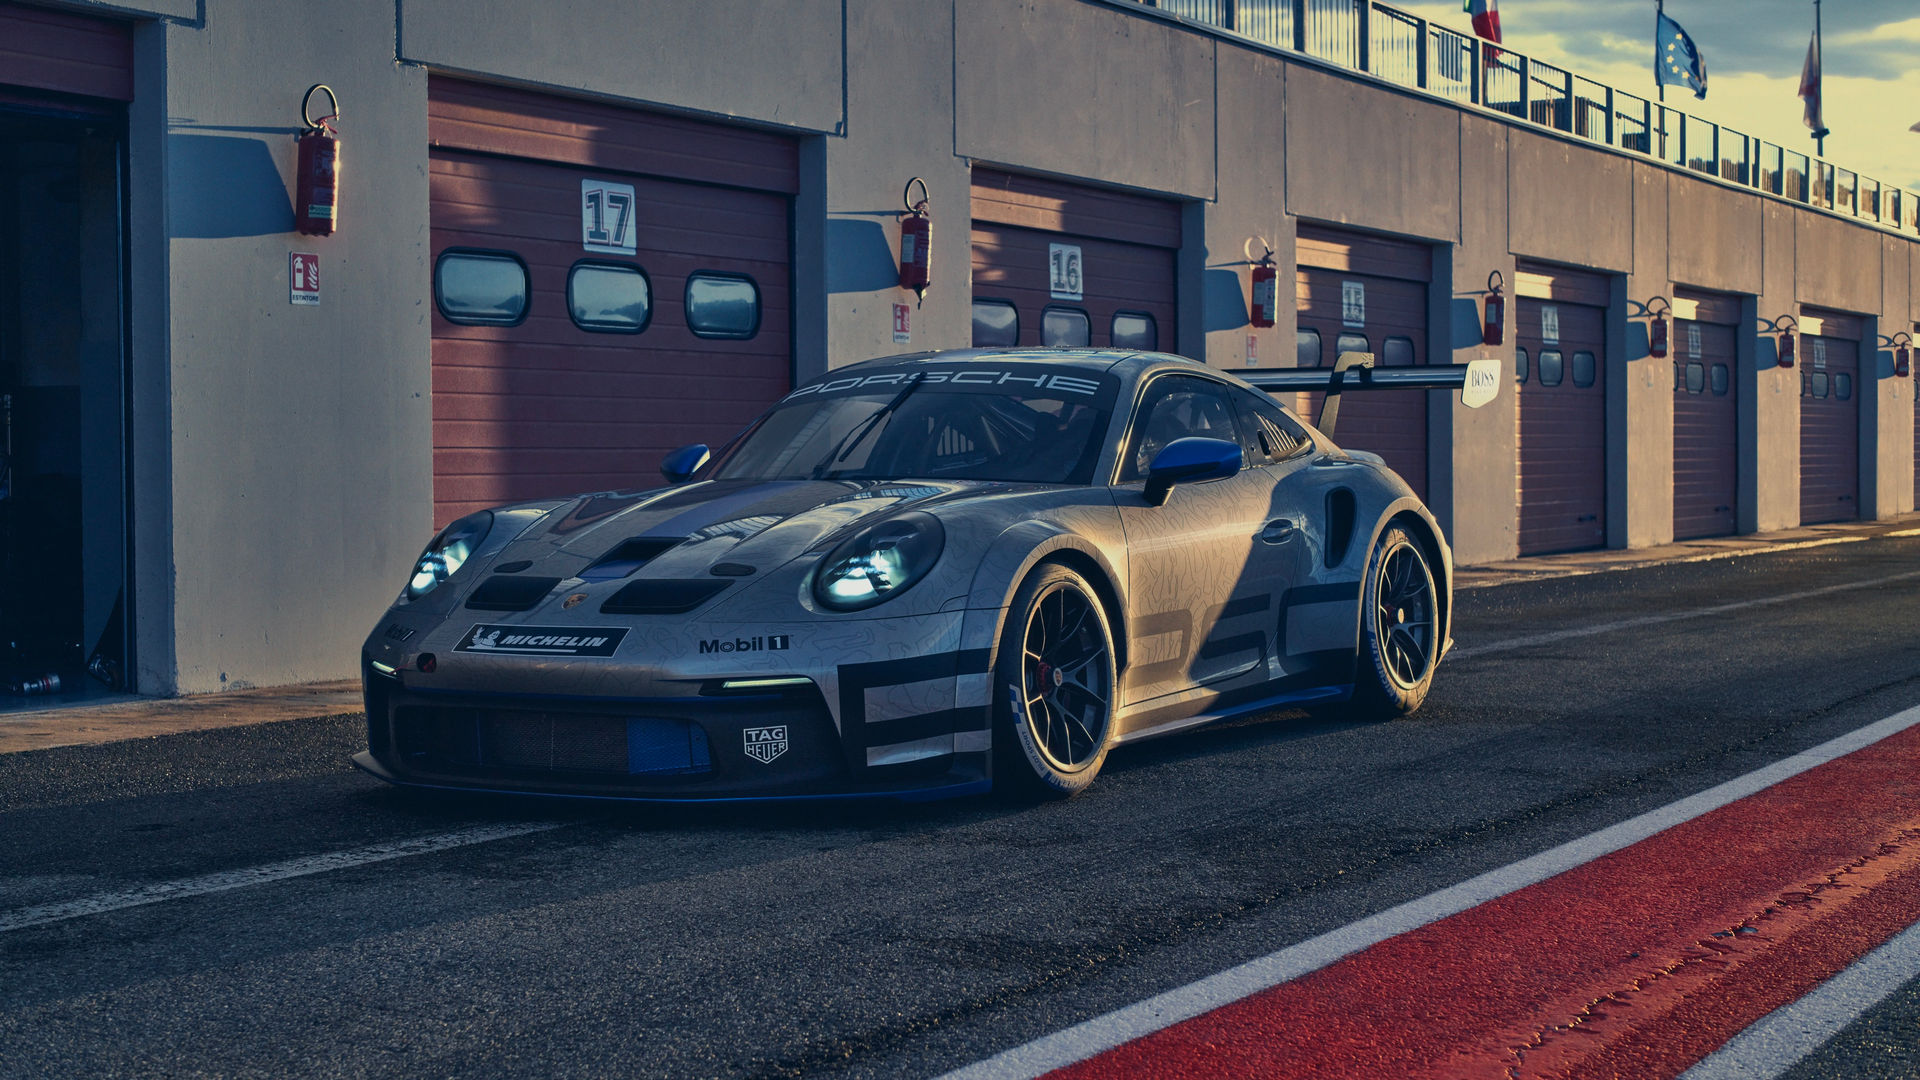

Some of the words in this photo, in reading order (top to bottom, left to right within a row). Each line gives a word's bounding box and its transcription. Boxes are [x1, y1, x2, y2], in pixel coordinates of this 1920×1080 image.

[586, 189, 632, 247] 17
[1052, 250, 1080, 294] 16
[292, 294, 320, 303] ESTINTORE
[781, 371, 1100, 404] PORSCHE
[1471, 369, 1495, 388] BOSS
[500, 634, 609, 647] MICHELIN
[699, 636, 763, 654] Mobil
[747, 728, 784, 742] TAG
[1022, 730, 1034, 753] SPORT
[747, 742, 786, 761] HEUER
[1032, 752, 1045, 772] PILOT
